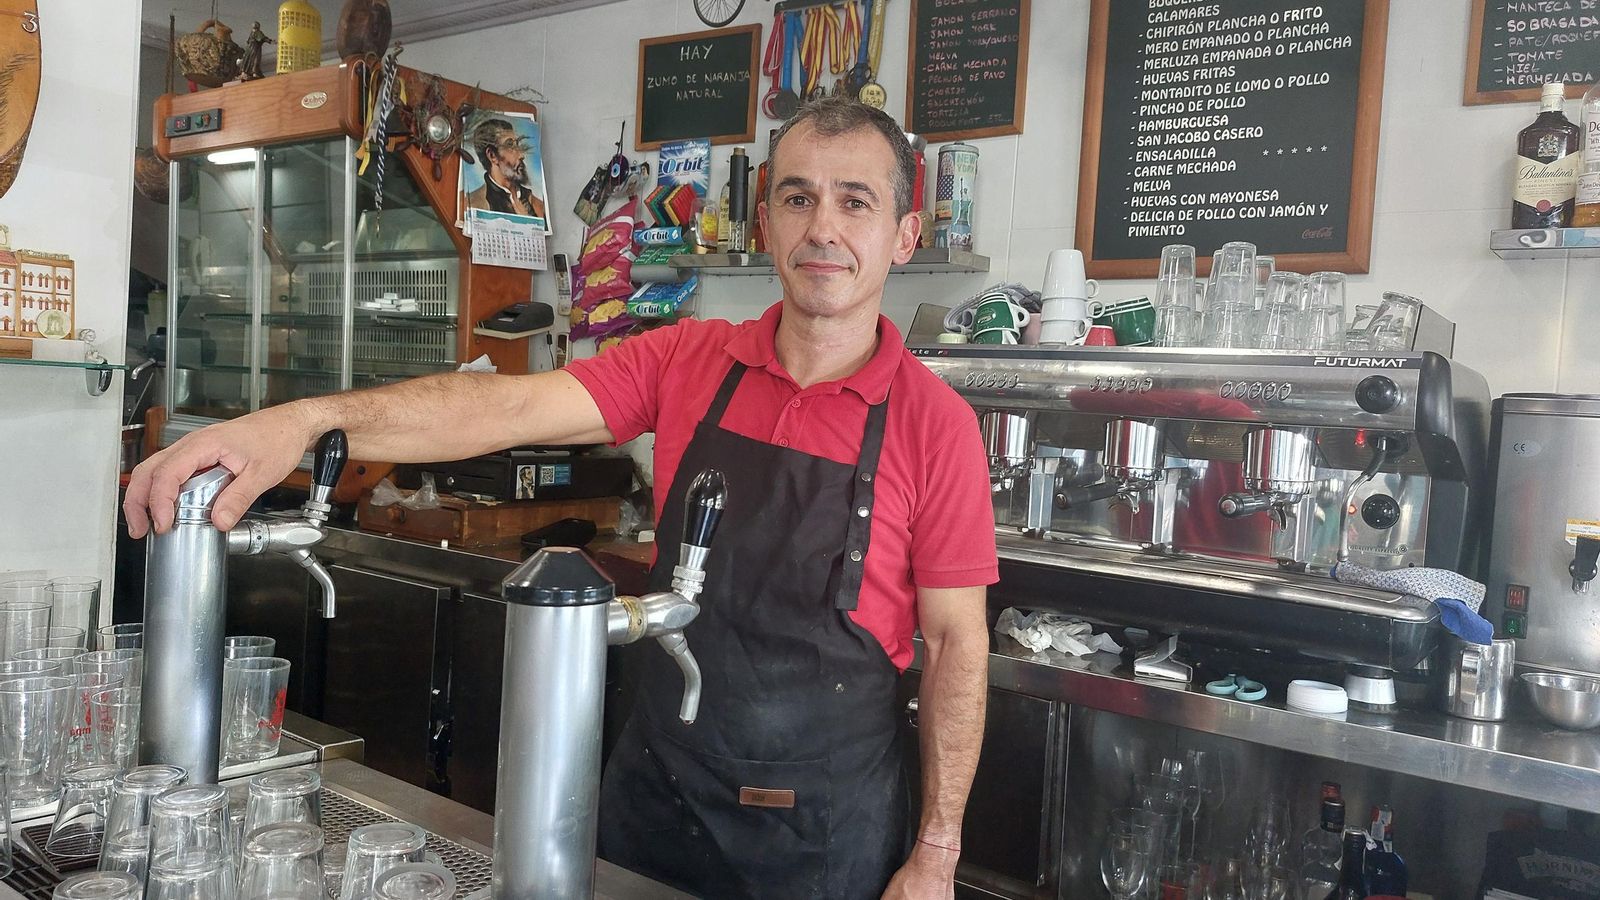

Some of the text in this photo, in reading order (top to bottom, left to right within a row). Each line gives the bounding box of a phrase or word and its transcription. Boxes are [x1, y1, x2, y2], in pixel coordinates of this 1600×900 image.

[1148, 4, 1220, 24] CALAMARES
[1507, 0, 1597, 13] MANTECA DE
[21, 11, 37, 33] 3
[931, 15, 964, 27] JAMON
[1146, 6, 1323, 39] CHIPIRÓN PLANCHA O FRITO
[930, 28, 964, 40] JAMON
[1145, 22, 1329, 55] MERO EMPANADO O PLANCHA
[680, 44, 713, 61] HAY
[1144, 36, 1352, 70] MERLUZA EMPANADA O PLANCHA
[1507, 50, 1563, 63] TOMATE
[647, 70, 750, 89] ZUMO DE NARANJA
[983, 71, 1006, 80] PAVO
[1143, 66, 1236, 85] HUEVAS FRITAS
[676, 88, 724, 101] NATURAL
[1141, 72, 1329, 101] MONTADITO DE LOMO O POLLO
[1140, 96, 1246, 116] PINCHO DE POLLO
[1138, 114, 1229, 132] HAMBURGUESA
[1137, 126, 1263, 147] SAN JACOBO CASERO
[1136, 147, 1216, 162] ENSALADILLA
[662, 157, 704, 175] Orbit
[1134, 160, 1236, 177] CARNE MECHADA
[1133, 180, 1171, 192] MELVA
[1131, 189, 1279, 207] HUEVAS CON MAYONESA
[1131, 202, 1328, 222] DELICIA DE POLLO CON JAMÓN Y
[643, 231, 669, 240] Orbit
[1128, 224, 1185, 237] PIMIENTO
[635, 306, 661, 316] Orbit
[1313, 357, 1407, 368] FUTURMAT
